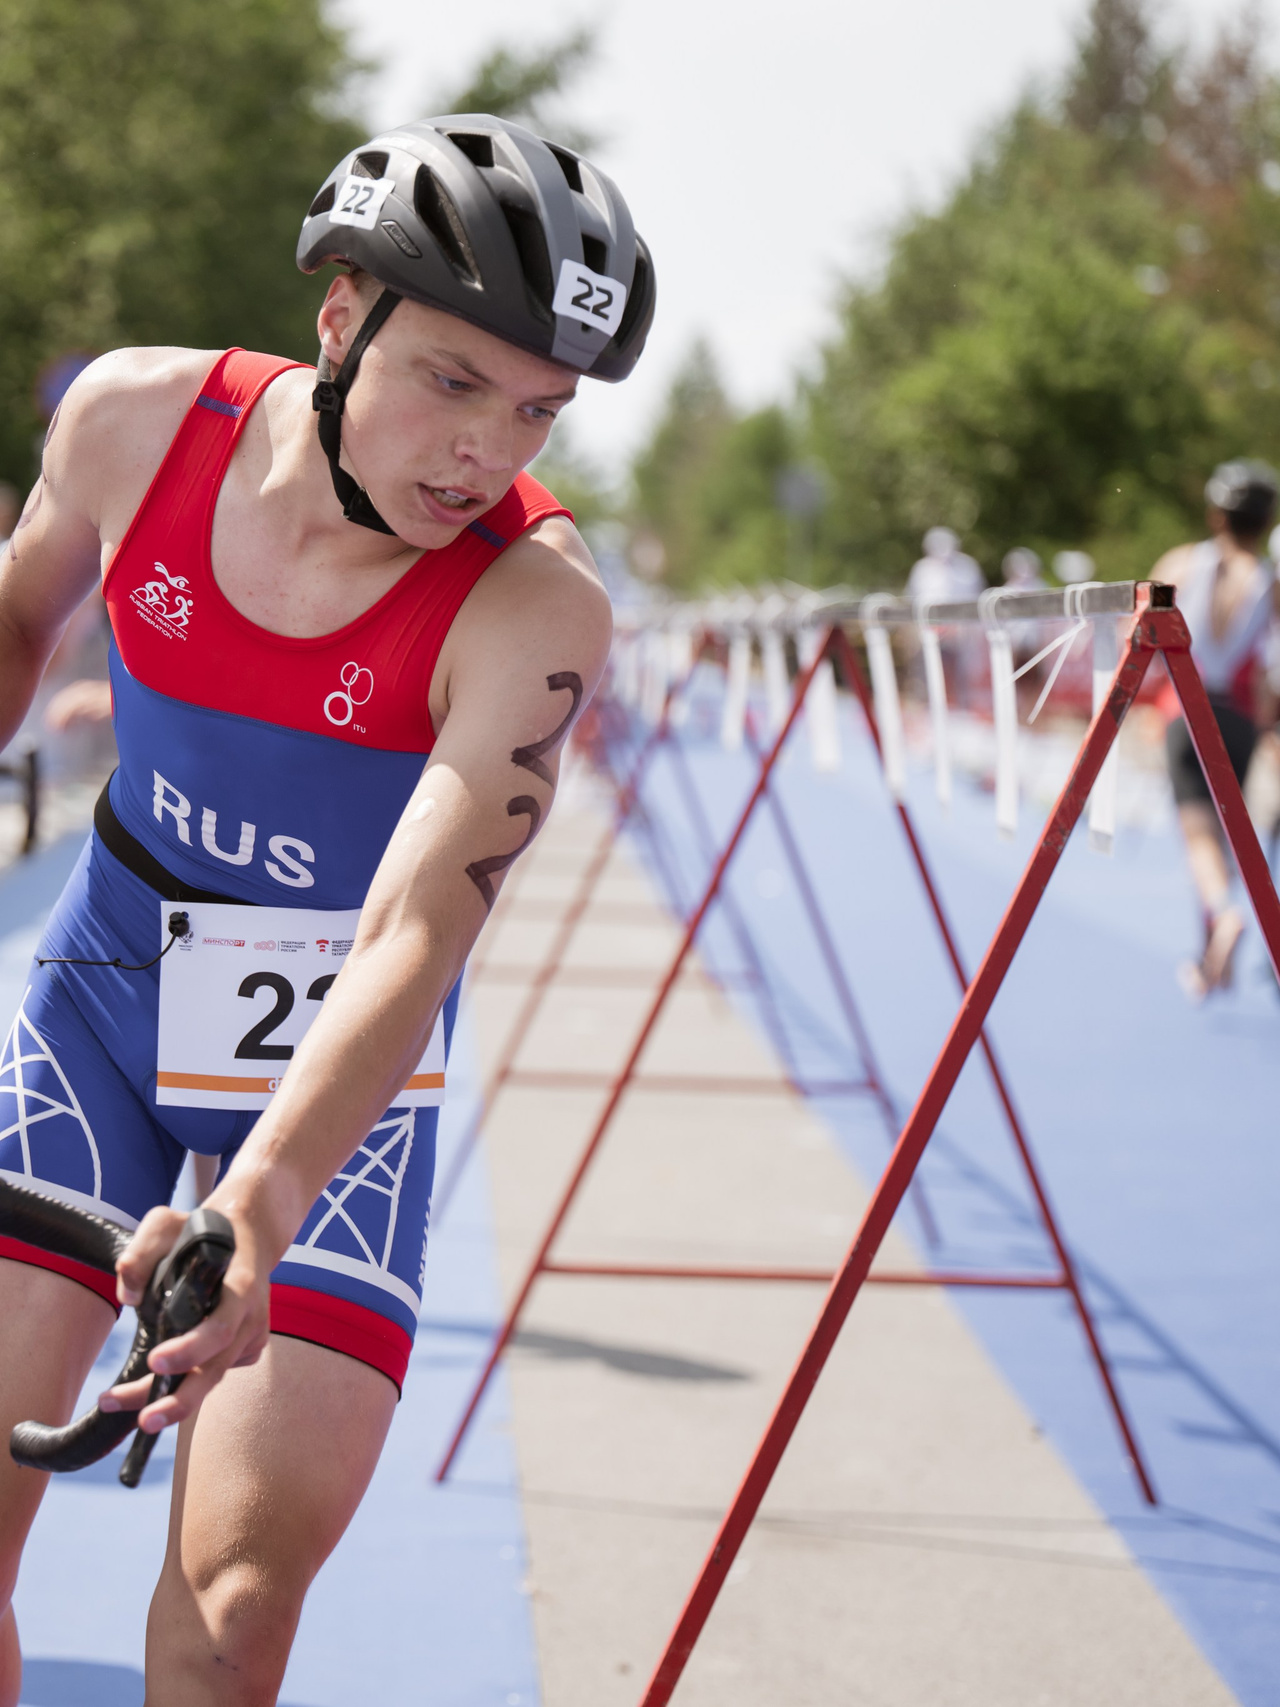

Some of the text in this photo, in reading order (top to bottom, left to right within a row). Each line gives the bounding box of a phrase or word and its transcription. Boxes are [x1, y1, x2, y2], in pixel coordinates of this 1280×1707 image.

[341, 184, 375, 216] 22
[571, 276, 613, 320] 22
[129, 594, 187, 641] RUSSIAN TRIATHLON
[136, 609, 173, 640] FEDERATION
[353, 723, 367, 734] ITU
[152, 769, 317, 889] RUS
